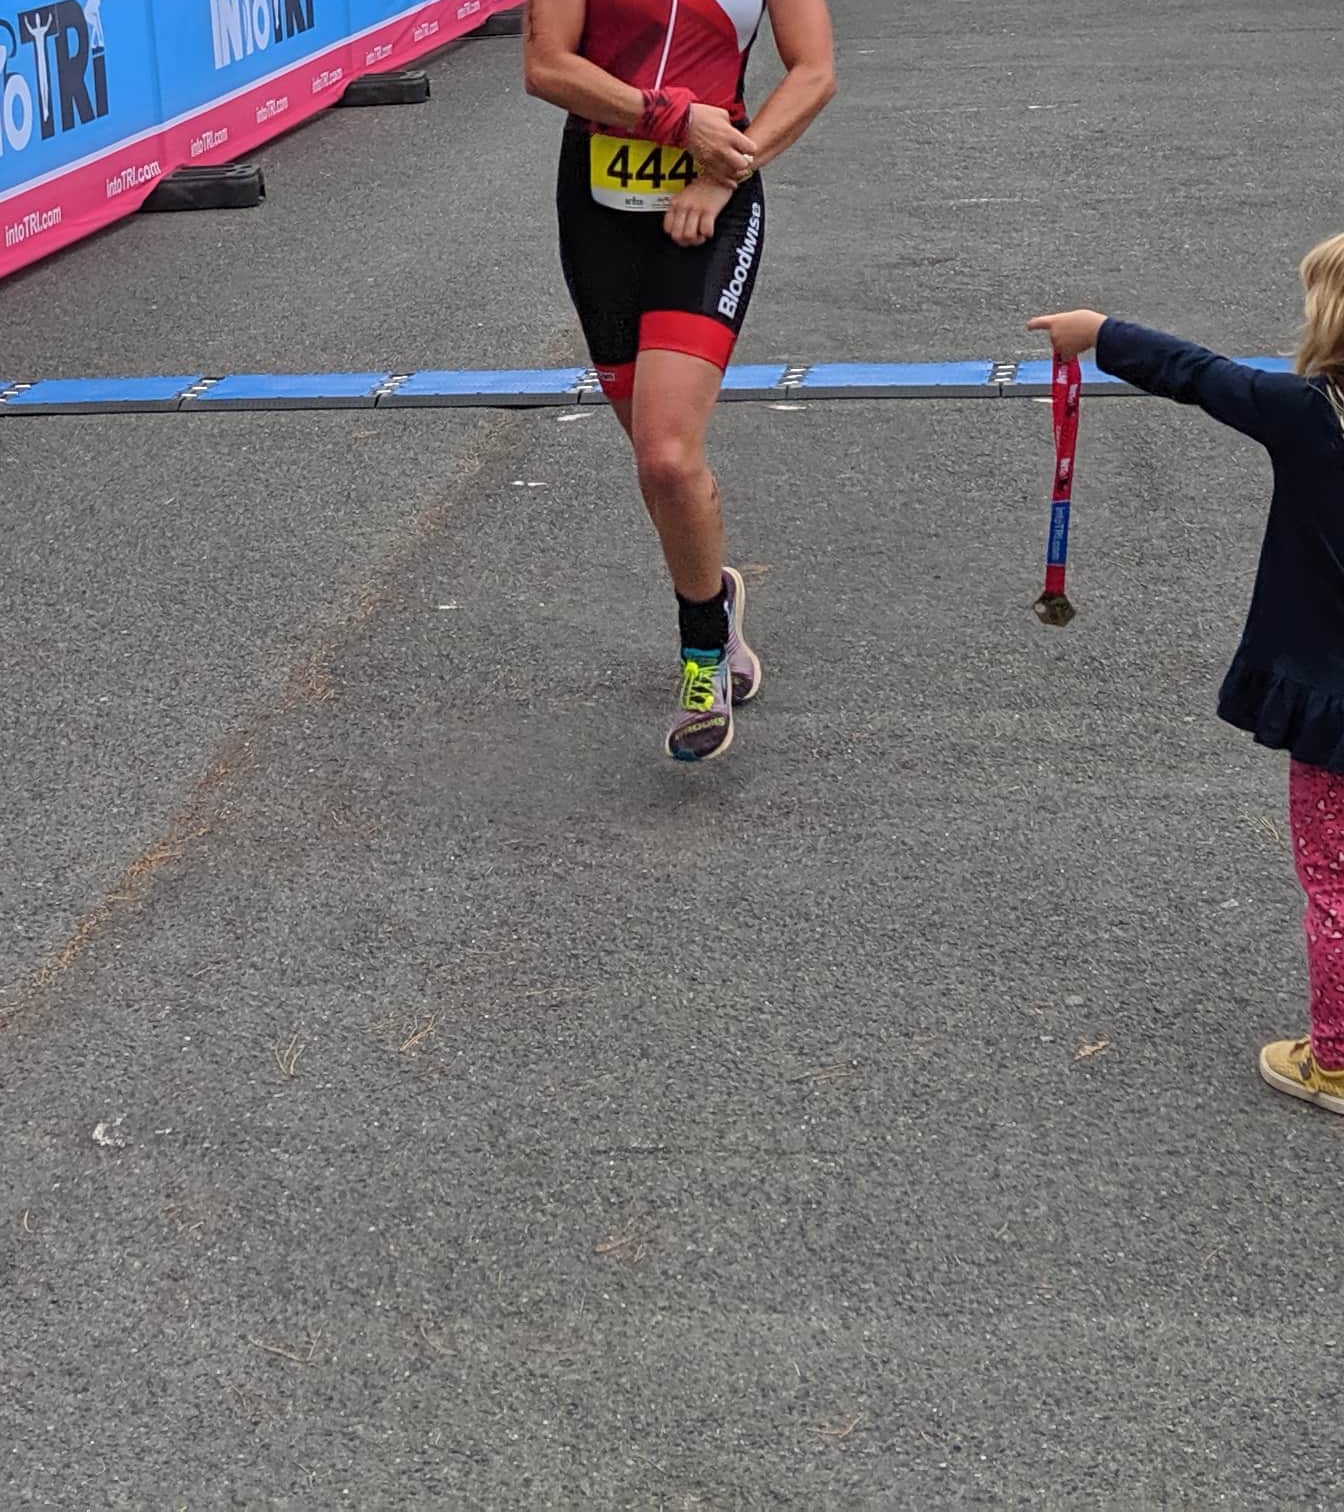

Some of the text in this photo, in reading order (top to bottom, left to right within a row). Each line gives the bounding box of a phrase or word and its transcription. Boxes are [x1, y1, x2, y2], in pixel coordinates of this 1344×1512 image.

[191, 127, 228, 157] intoTRI.com
[106, 161, 161, 198] intoTRI.com
[607, 145, 697, 189] 444
[5, 206, 62, 247] intoTRI.com
[718, 202, 761, 319] Bloodwise
